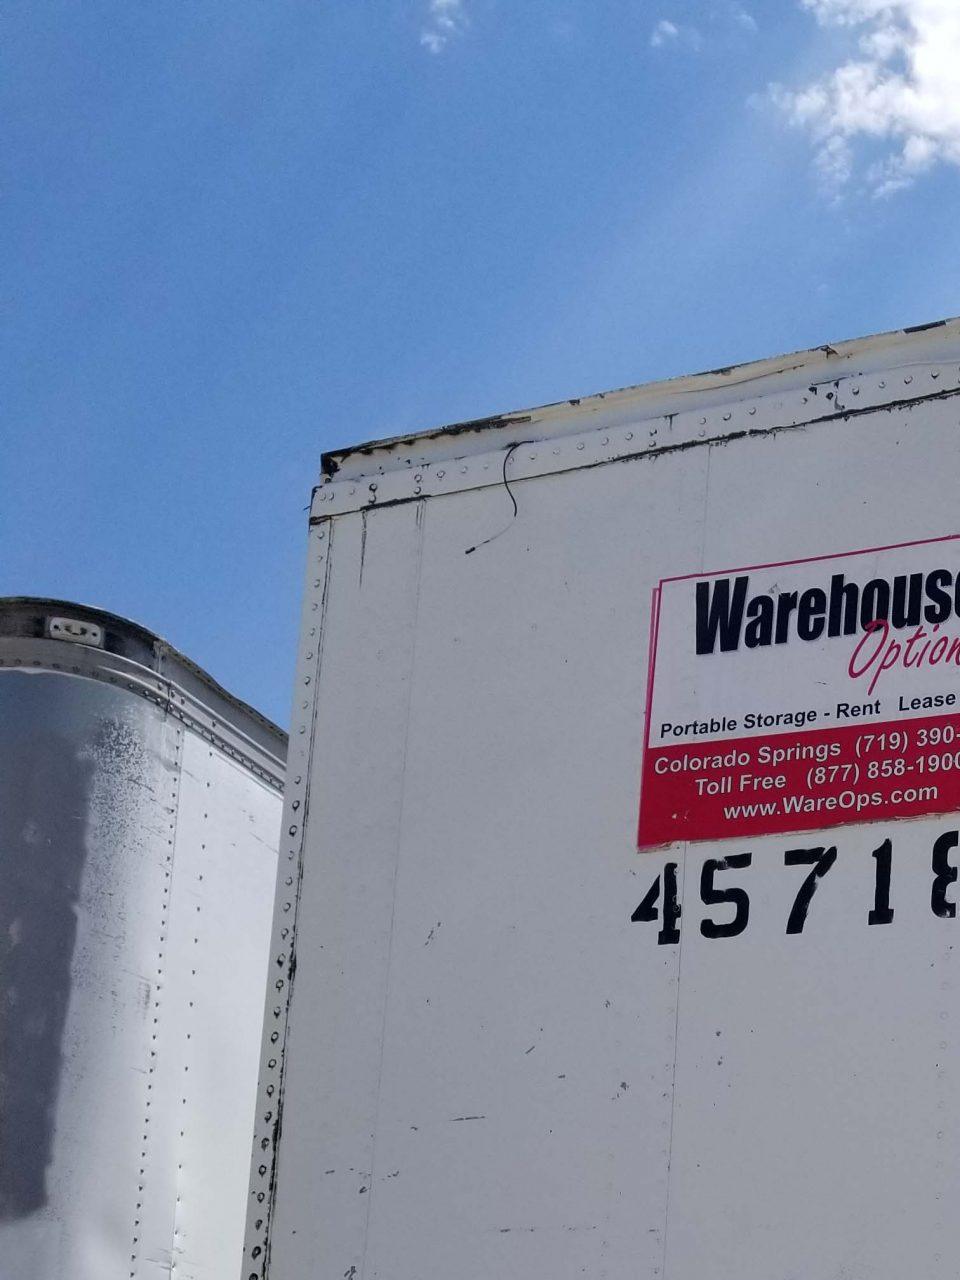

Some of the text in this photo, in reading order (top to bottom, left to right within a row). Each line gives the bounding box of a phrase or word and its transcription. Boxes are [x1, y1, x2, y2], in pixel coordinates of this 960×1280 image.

[660, 717, 738, 738] Portable
[743, 710, 818, 729] Storage
[836, 700, 881, 719] Rent
[898, 693, 957, 712] Lease
[654, 750, 751, 775] Colorado
[757, 742, 842, 767] Springs
[855, 731, 908, 758] (719)
[695, 776, 732, 796] Toll
[739, 774, 787, 792] Free
[806, 763, 860, 789] (877)
[723, 785, 939, 820] www.WareOps.com
